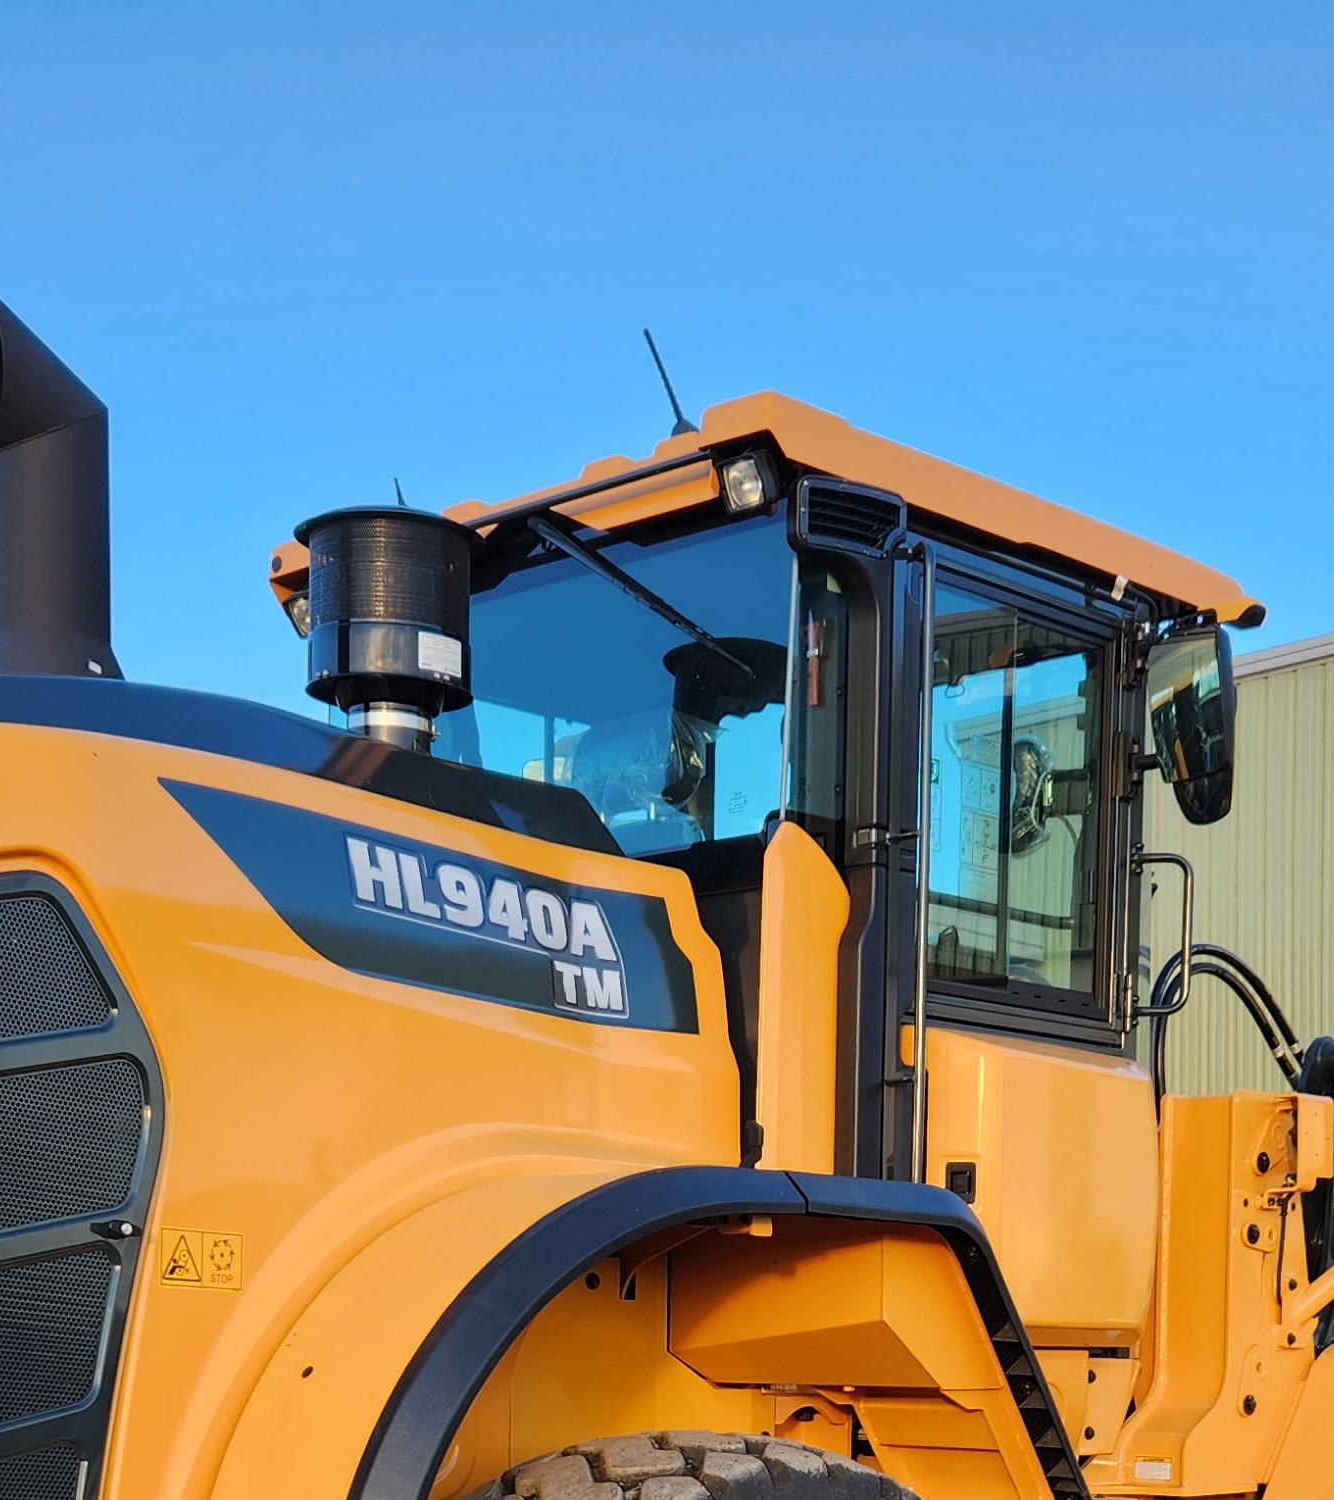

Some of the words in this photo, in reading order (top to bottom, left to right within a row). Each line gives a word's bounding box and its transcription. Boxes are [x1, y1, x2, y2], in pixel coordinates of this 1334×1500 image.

[347, 837, 618, 962] HL940A
[555, 963, 623, 1012] TM
[210, 1274, 234, 1284] STOP
